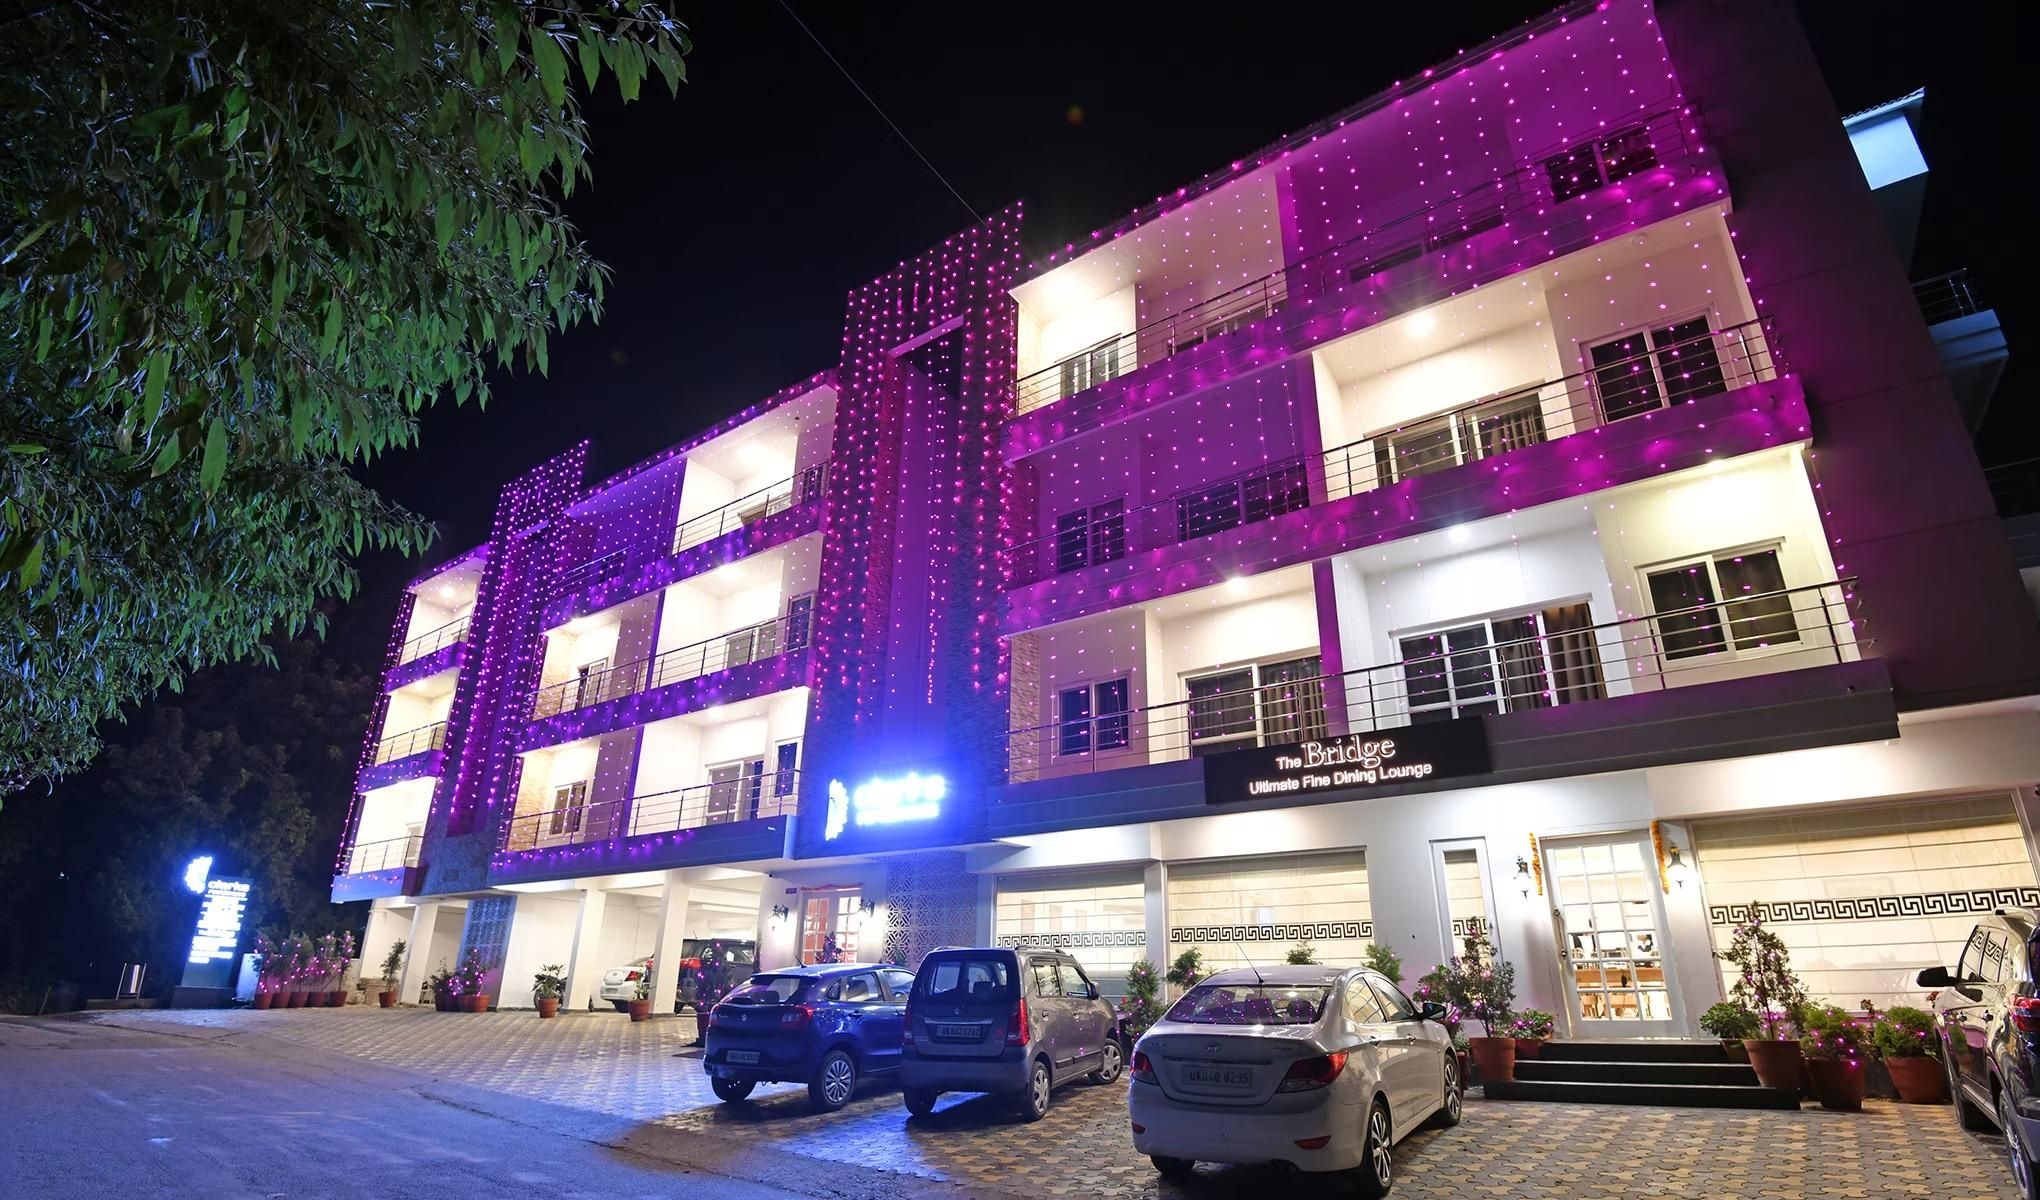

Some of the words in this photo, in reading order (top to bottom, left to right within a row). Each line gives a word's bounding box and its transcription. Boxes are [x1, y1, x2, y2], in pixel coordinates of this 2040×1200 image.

[1276, 756, 1301, 770] The
[1301, 734, 1396, 769] Bridge
[1249, 777, 1300, 795] Ultimate
[1302, 773, 1331, 788] Fine
[1333, 768, 1377, 784] Dining
[1379, 762, 1433, 779] Lounge
